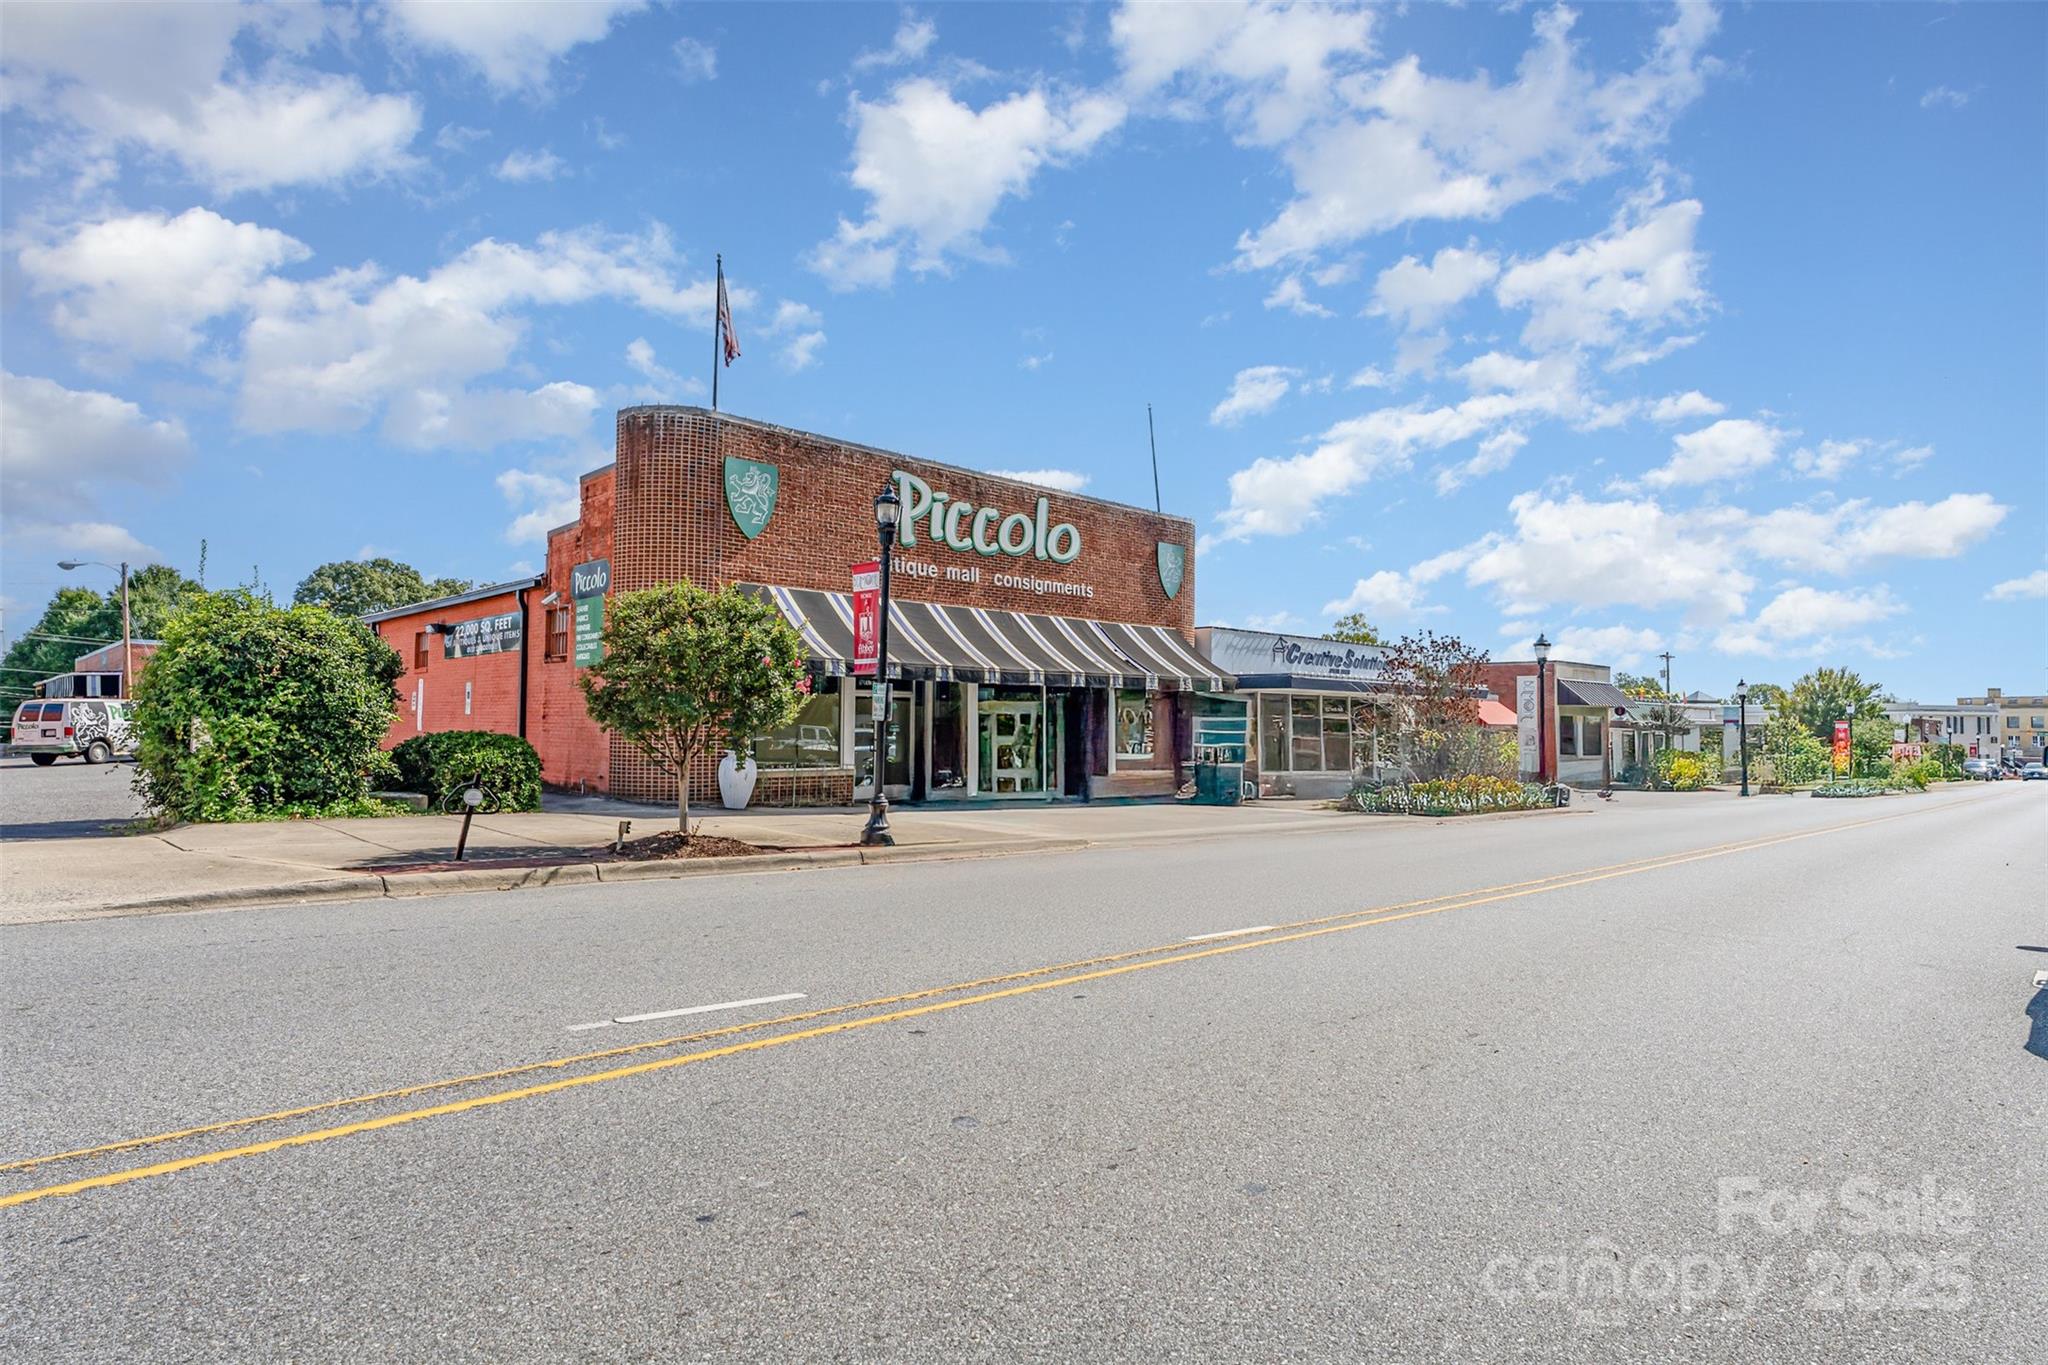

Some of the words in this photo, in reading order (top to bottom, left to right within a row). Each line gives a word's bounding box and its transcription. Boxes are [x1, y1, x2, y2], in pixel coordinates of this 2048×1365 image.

[892, 470, 1081, 563] Piccolo
[575, 567, 607, 595] Piccolo
[872, 556, 938, 579] tique
[946, 565, 980, 583] mall
[994, 573, 1094, 598] consignments
[455, 623, 479, 637] 22,000
[480, 620, 493, 633] SQ.
[495, 616, 512, 630] FEET
[504, 629, 521, 640] ITEMS
[1343, 649, 1387, 670] Solutio
